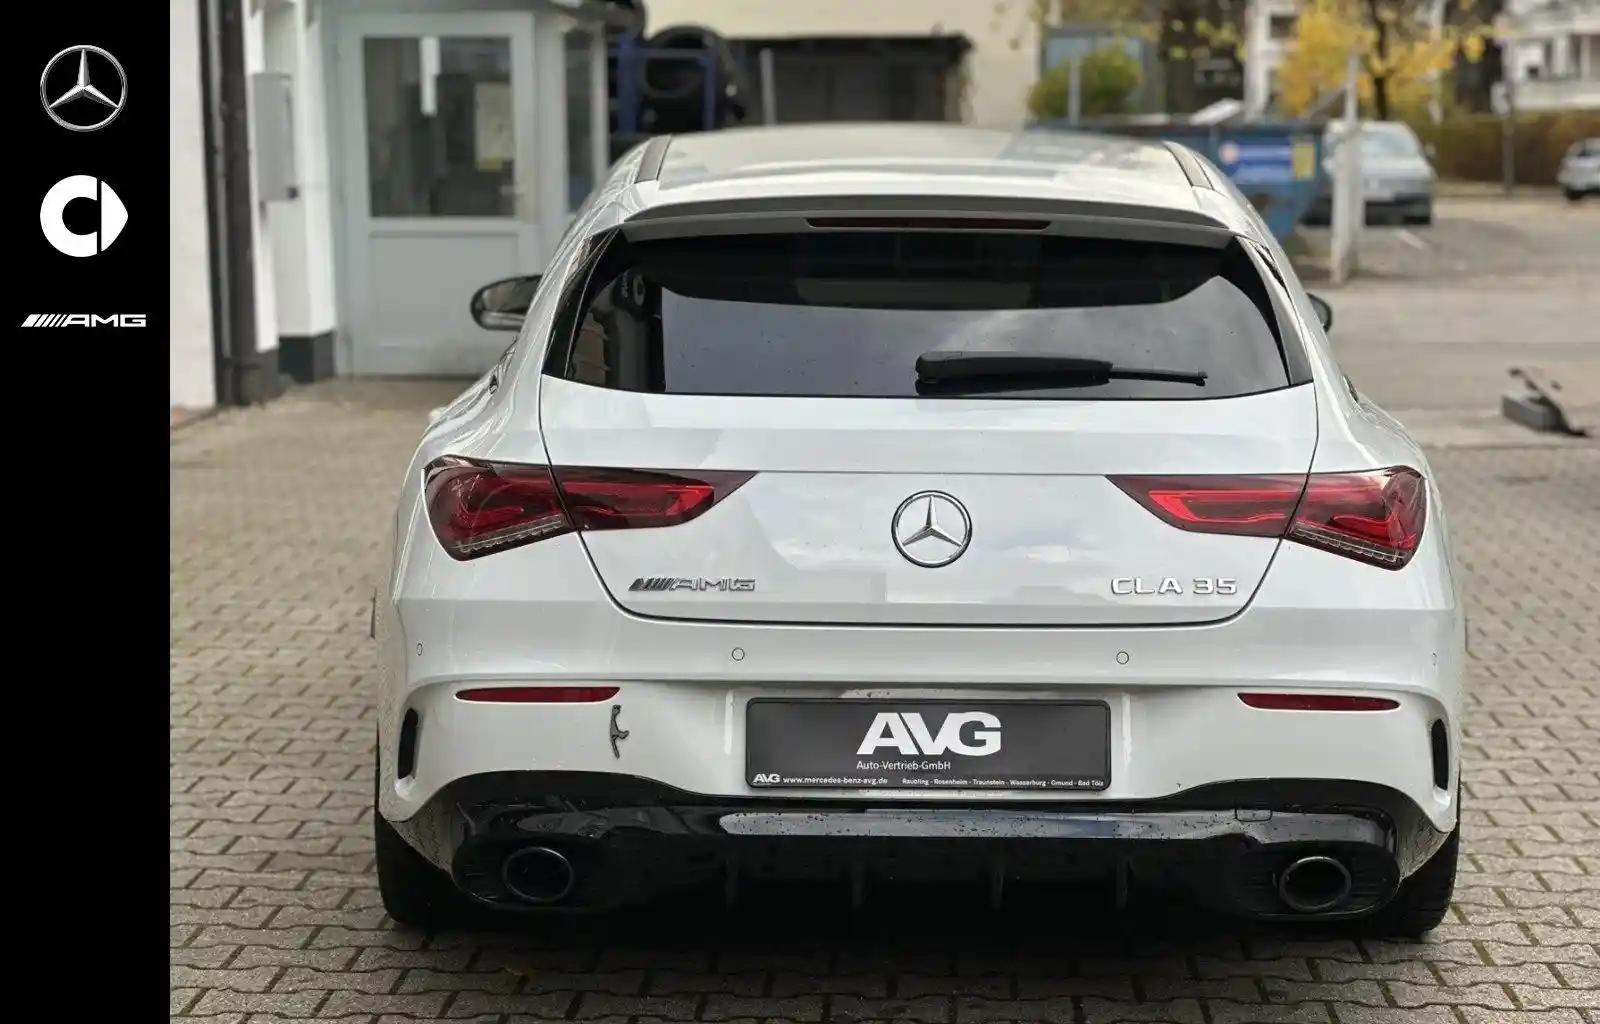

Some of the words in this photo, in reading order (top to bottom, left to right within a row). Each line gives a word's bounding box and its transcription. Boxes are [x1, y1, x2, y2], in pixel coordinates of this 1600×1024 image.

[668, 578, 756, 592] AMG
[1110, 577, 1183, 595] CLA
[1192, 577, 1238, 595] 35
[856, 711, 1002, 757] AVG
[856, 760, 951, 770] Auto-Vertrieb-GmbH
[752, 773, 781, 784] AVG
[783, 775, 889, 786] www.mercedes-benz-avg.de
